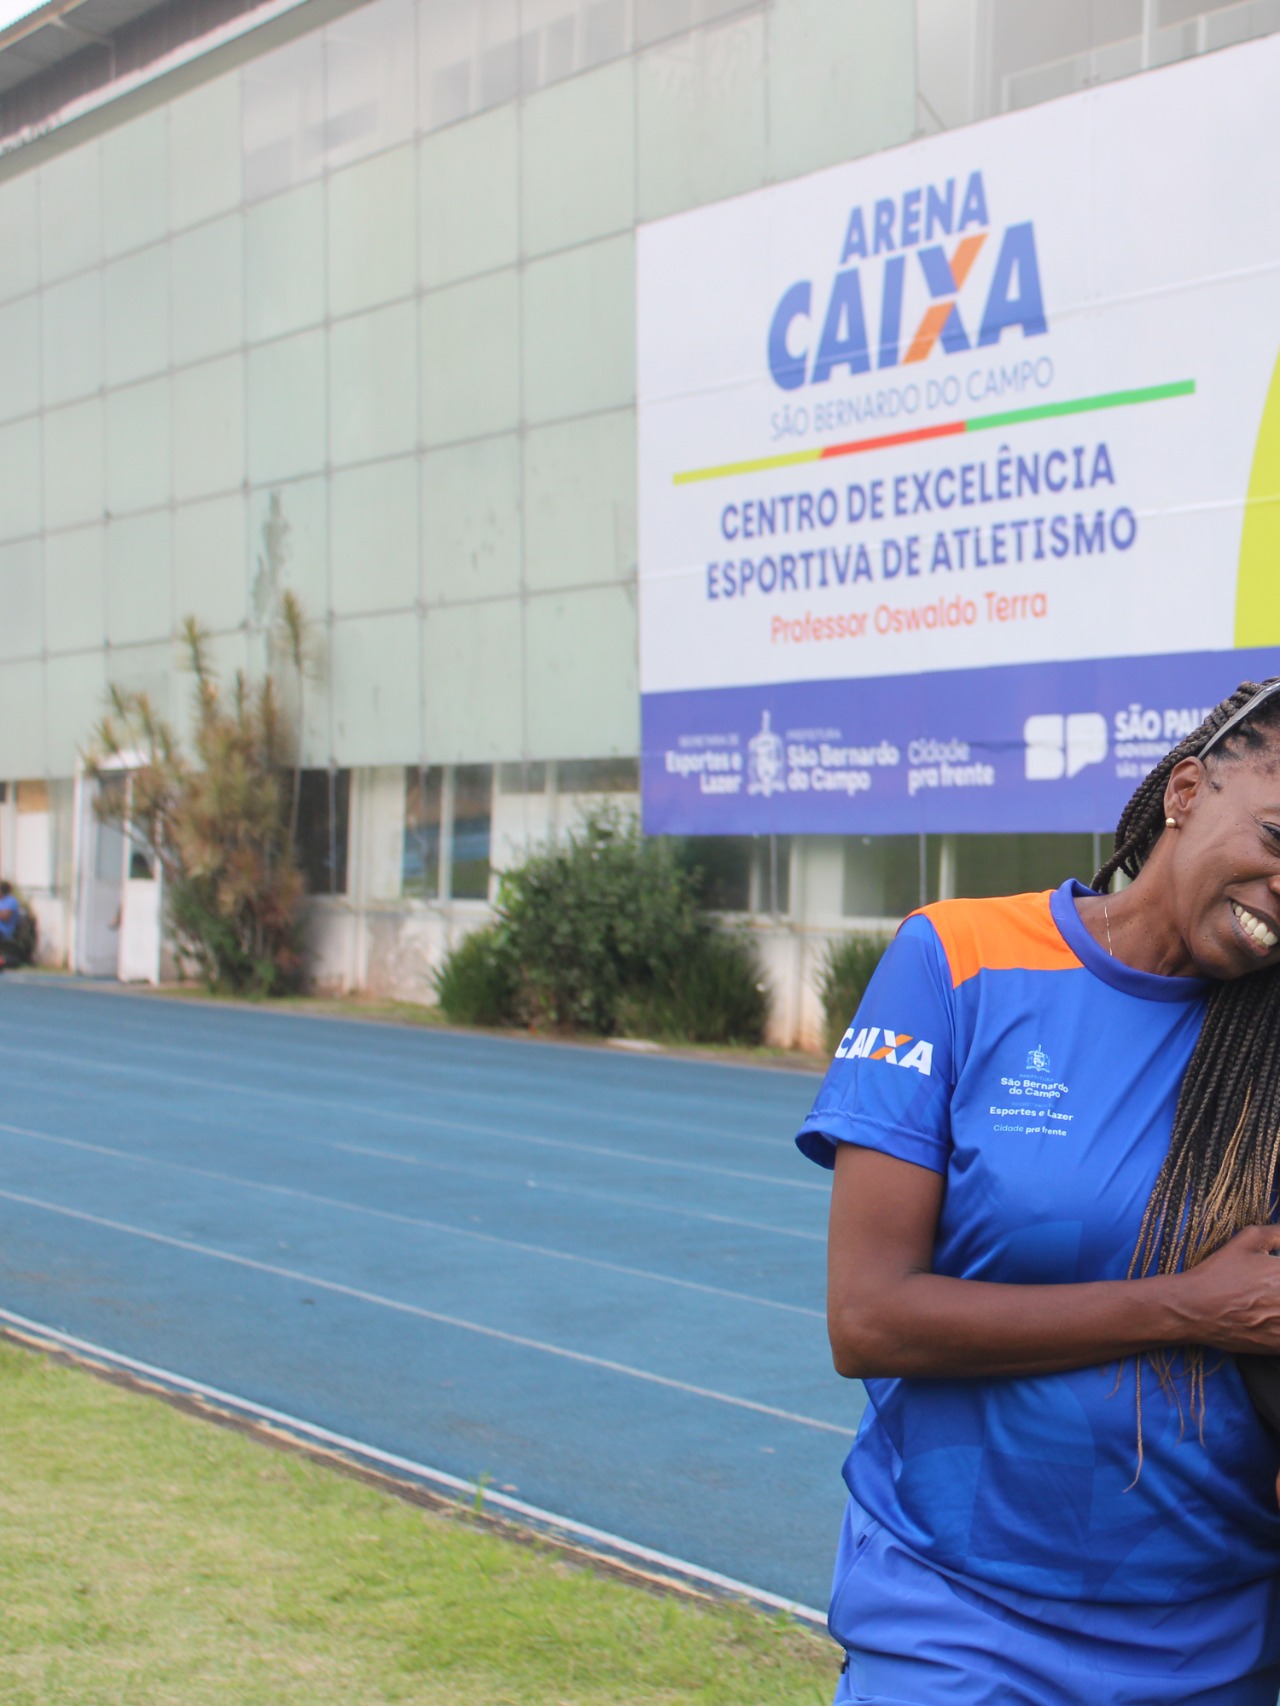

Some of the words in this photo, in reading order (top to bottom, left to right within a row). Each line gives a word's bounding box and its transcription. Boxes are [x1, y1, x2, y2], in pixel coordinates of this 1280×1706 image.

[839, 170, 990, 266] ARENA
[767, 221, 1049, 391] CAIXA
[771, 403, 808, 441] SÃO
[814, 384, 921, 433] BERNARDO
[926, 375, 961, 410] DO
[966, 357, 1054, 402] CAMPO
[721, 488, 839, 541] CENTRO
[847, 479, 885, 524] DE
[894, 442, 1116, 517] EXCELÊNCIA
[707, 543, 873, 601] ESPORTIVA
[882, 536, 920, 580] DE
[930, 506, 1137, 574] ATLETISMO
[771, 611, 869, 645] Professor
[874, 594, 977, 636] Oswaldo
[983, 591, 1048, 623] Terra
[1114, 703, 1161, 741] SÃO
[665, 750, 730, 779] Esportes
[787, 743, 818, 768] São
[819, 740, 899, 768] Bernardo
[908, 737, 970, 766] Cidade
[701, 771, 743, 794] Lazer
[787, 768, 809, 791] do
[811, 767, 871, 798] Campo
[908, 768, 939, 797] pra
[940, 762, 995, 787] frente
[835, 1027, 934, 1076] CAIXA
[1001, 1077, 1021, 1087] São
[1022, 1079, 1069, 1093] Bernardo
[1008, 1086, 1023, 1096] do
[1024, 1087, 1061, 1099] Campo
[989, 1106, 1037, 1117] Esportes
[1046, 1109, 1075, 1121] Lazer
[993, 1124, 1024, 1132] Cidade
[1025, 1126, 1040, 1135] pra
[1041, 1125, 1067, 1136] frente
